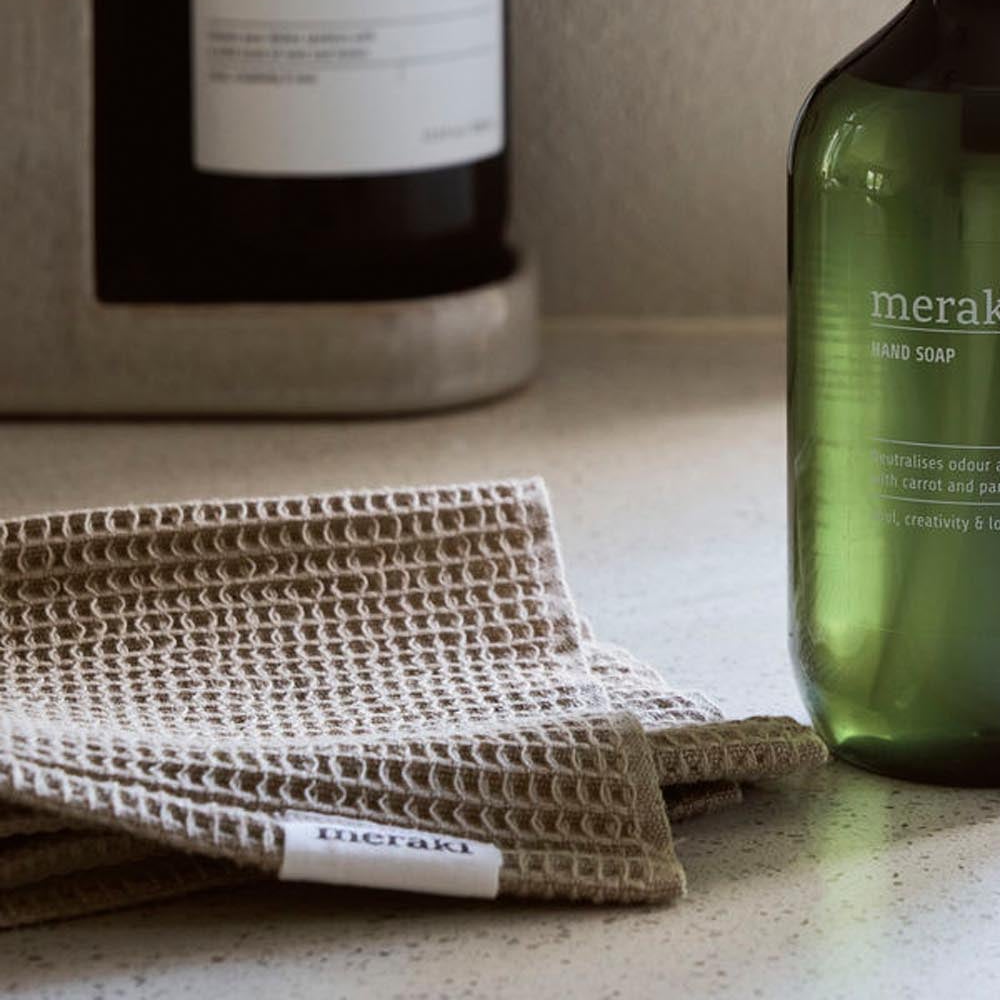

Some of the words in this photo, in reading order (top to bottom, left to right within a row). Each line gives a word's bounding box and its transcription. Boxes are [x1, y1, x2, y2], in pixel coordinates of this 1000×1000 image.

[870, 341, 911, 361] HAND
[916, 345, 956, 363] SOAP
[948, 458, 991, 472] odour
[902, 477, 942, 492] carrot
[947, 479, 974, 493] and
[904, 513, 969, 533] creativity
[974, 516, 983, 530] &
[317, 826, 474, 855] meraki
